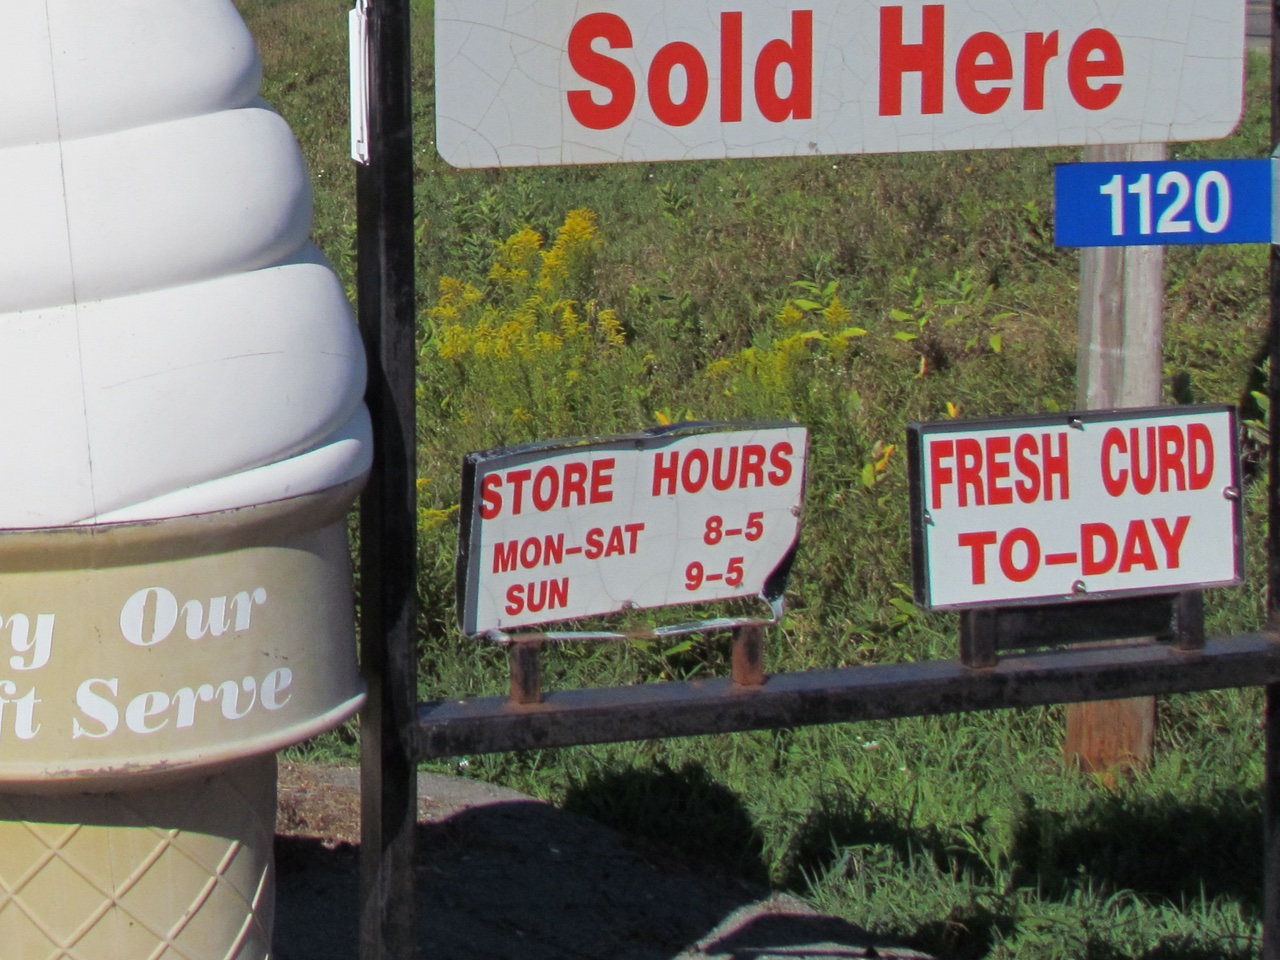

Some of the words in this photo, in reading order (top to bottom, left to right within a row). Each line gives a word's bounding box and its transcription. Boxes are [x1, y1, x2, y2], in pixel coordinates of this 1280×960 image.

[568, 11, 812, 129] Sold
[880, 5, 1123, 115] Here
[1100, 171, 1231, 237] 1120
[479, 458, 615, 520] STORE
[653, 442, 792, 495] HOURS
[931, 433, 1068, 508] FRESH
[1102, 424, 1213, 496] CURD
[494, 524, 644, 572] MON-SAT
[705, 513, 762, 544] 8-5
[959, 517, 1189, 584] TO-DAY
[120, 586, 267, 647] Our
[506, 578, 568, 615] SUN
[686, 558, 743, 590] 9-5
[72, 666, 293, 739] Serve
